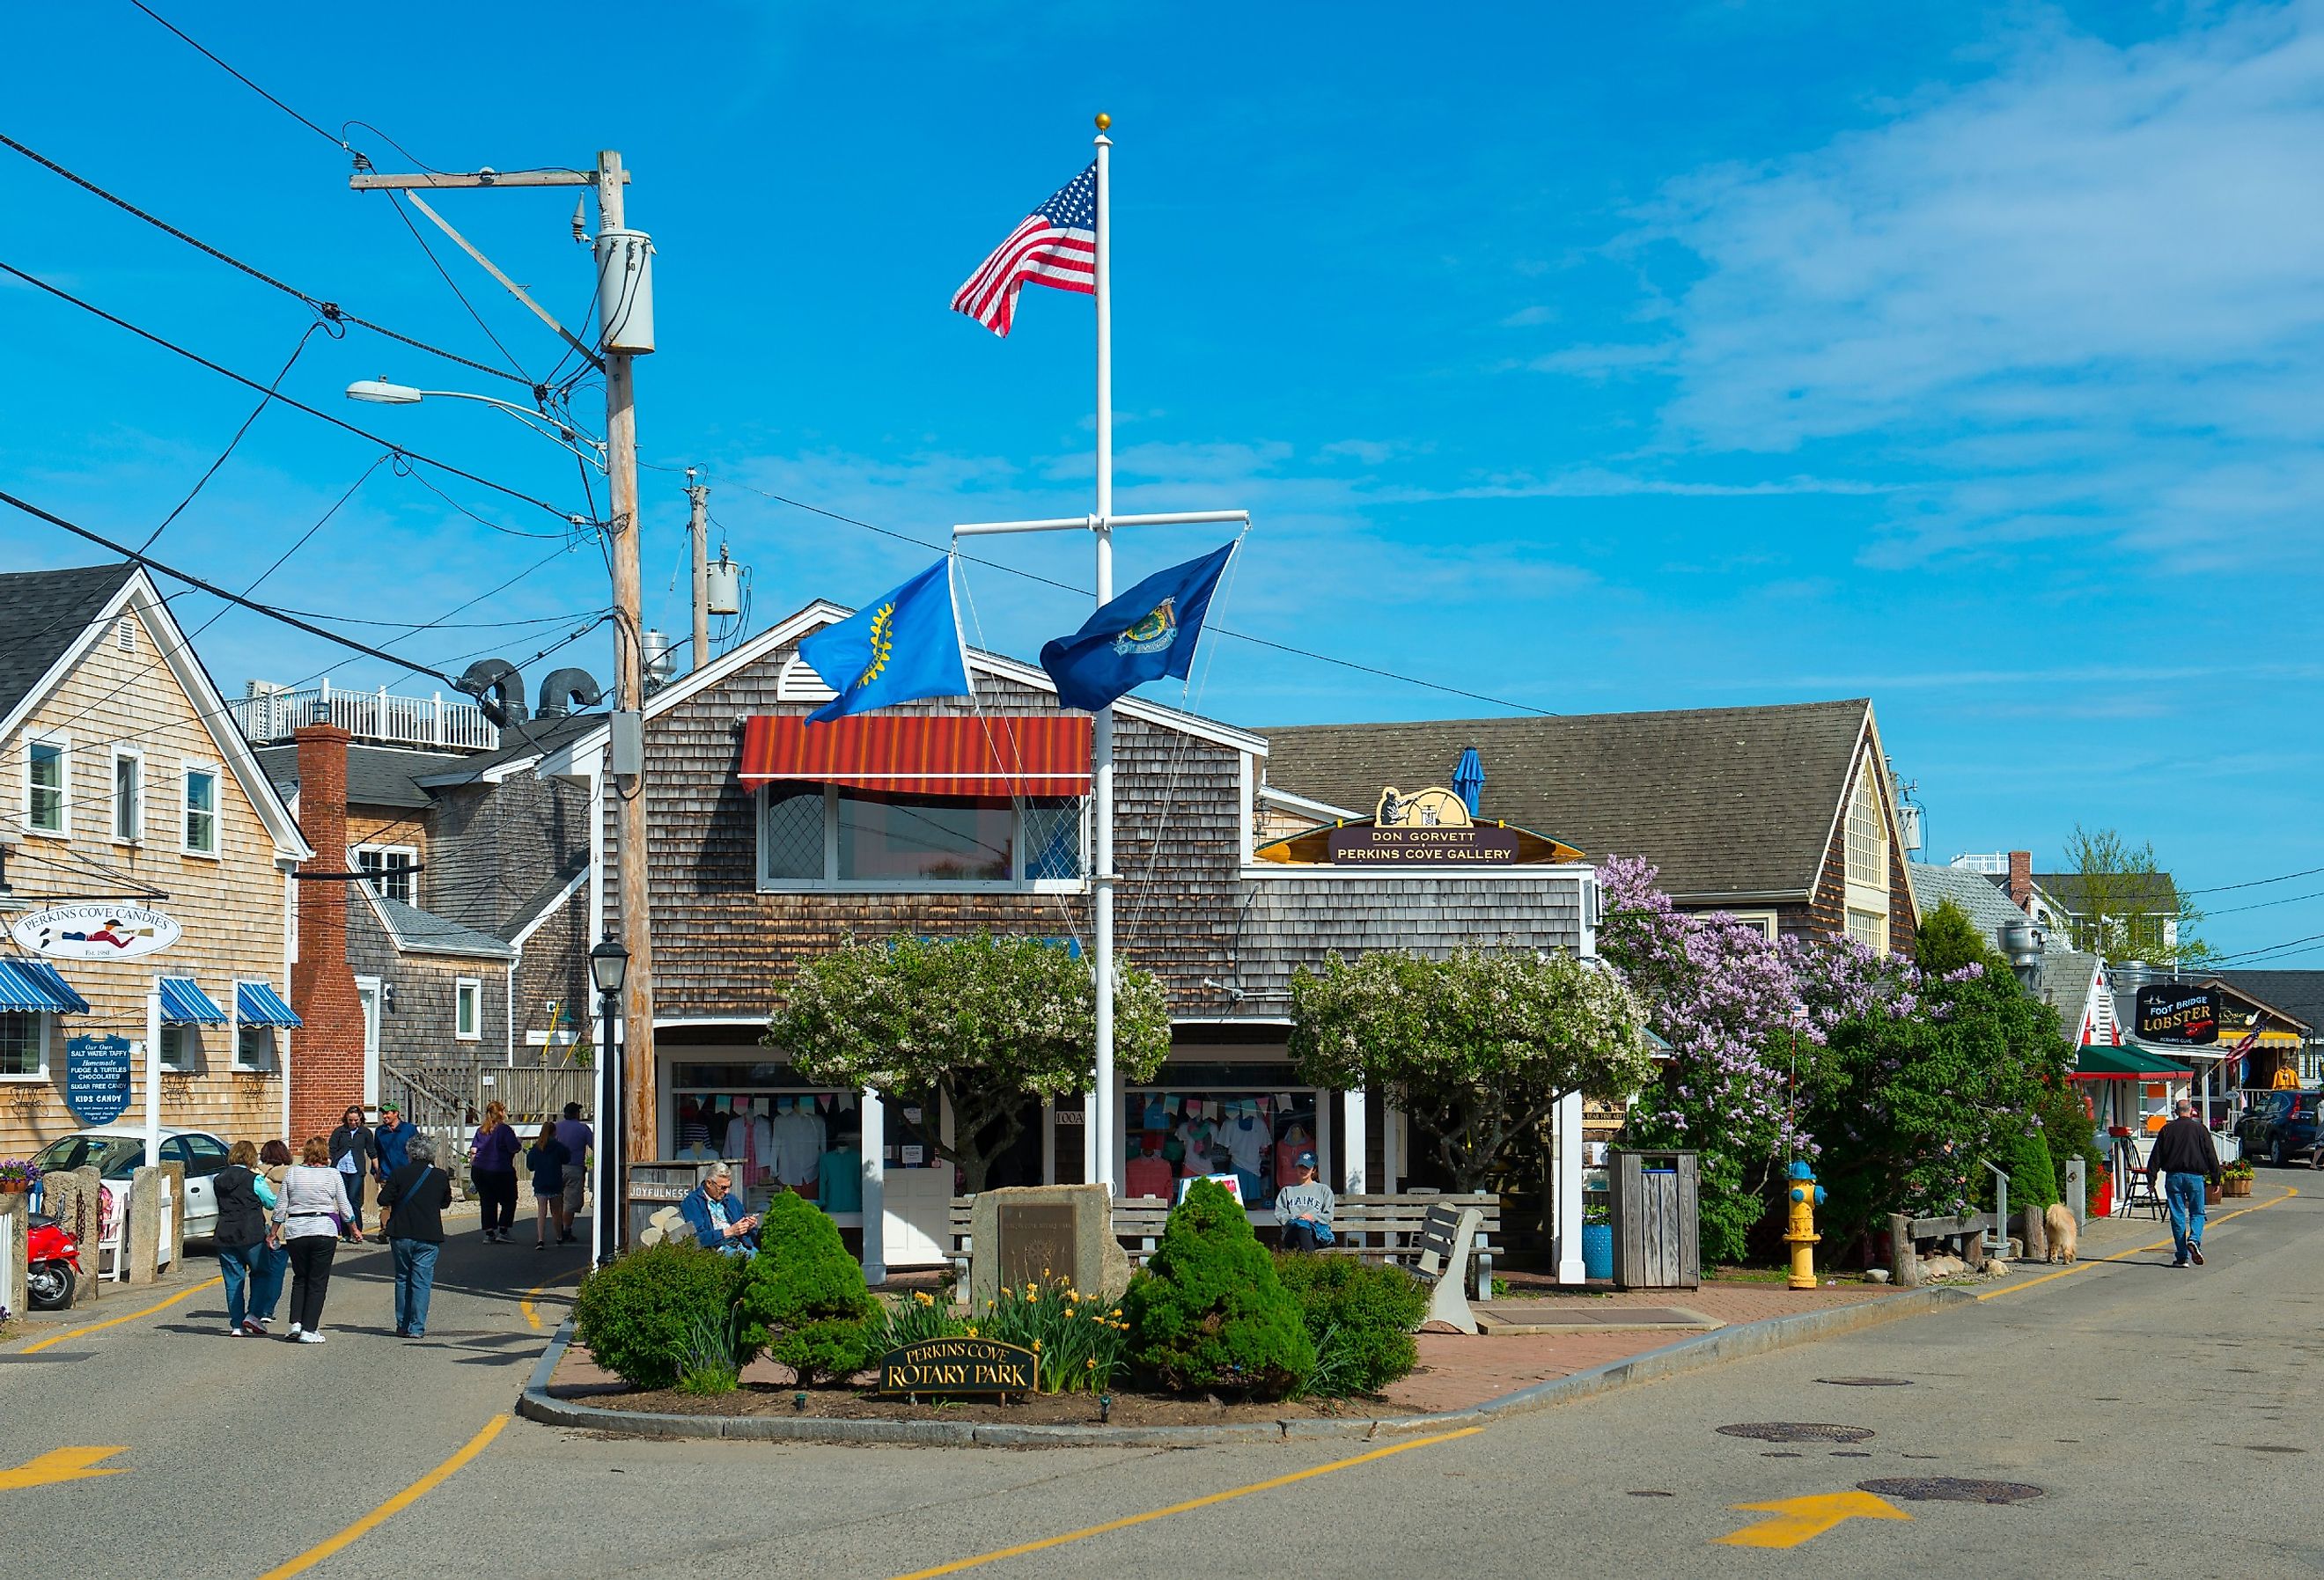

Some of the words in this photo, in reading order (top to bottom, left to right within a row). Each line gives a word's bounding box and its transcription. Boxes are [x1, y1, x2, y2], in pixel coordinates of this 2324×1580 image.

[1372, 832, 1402, 841] DON
[1409, 832, 1475, 841] GORVETT
[1337, 849, 1401, 859] PERKINS
[1405, 849, 1443, 859] COVE
[1446, 849, 1511, 859] GALLERY
[24, 910, 77, 930] PERKINS
[78, 908, 113, 918] COVE
[115, 909, 170, 930] CANDIES
[2150, 1003, 2173, 1016] FOOT
[2175, 996, 2208, 1010] BRIDGE
[2143, 1005, 2210, 1032] LOBSTER
[96, 1094, 121, 1103] CANDY
[630, 1187, 688, 1197] JOYFULNESS
[907, 1343, 965, 1363] PERKINS
[968, 1344, 1009, 1363] COVE
[888, 1365, 968, 1387] ROTARY
[975, 1365, 1027, 1386] PARK
